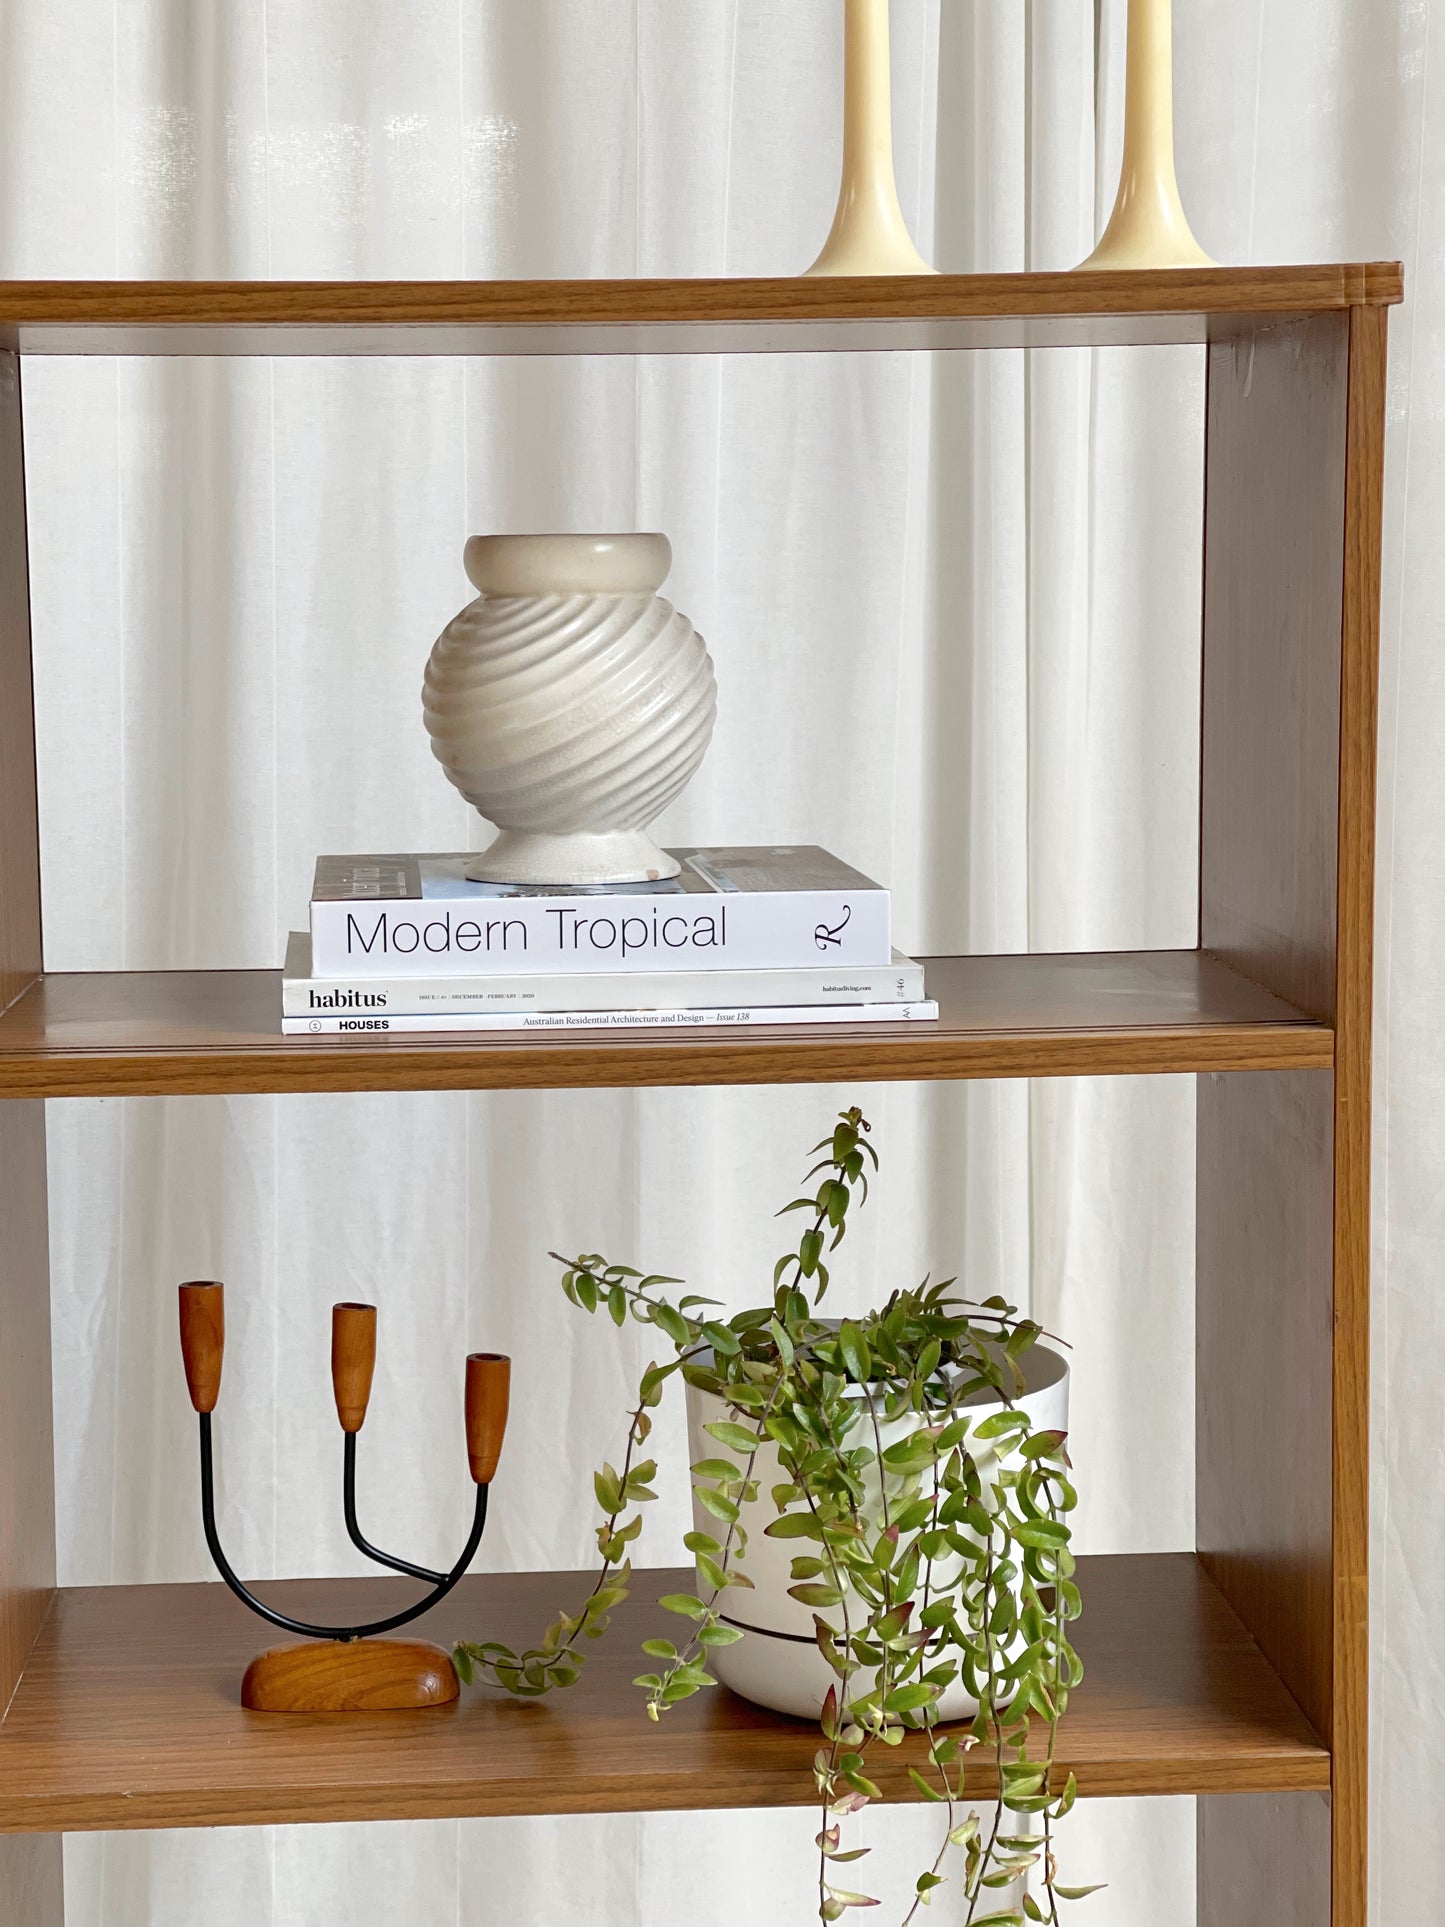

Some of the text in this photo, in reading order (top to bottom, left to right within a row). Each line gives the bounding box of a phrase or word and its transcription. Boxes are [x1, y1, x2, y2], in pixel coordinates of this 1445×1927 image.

[347, 905, 726, 958] Modern Tropical
[814, 904, 852, 951] R
[308, 989, 387, 1008] habitus
[339, 1020, 389, 1030] HOUSES
[523, 1017, 564, 1026] Australian
[566, 1016, 609, 1025] Residential
[610, 1014, 659, 1024] Architecture
[660, 1014, 676, 1022] and
[677, 1013, 705, 1023] Design
[716, 1012, 736, 1021] Issue
[736, 1012, 750, 1021] 138
